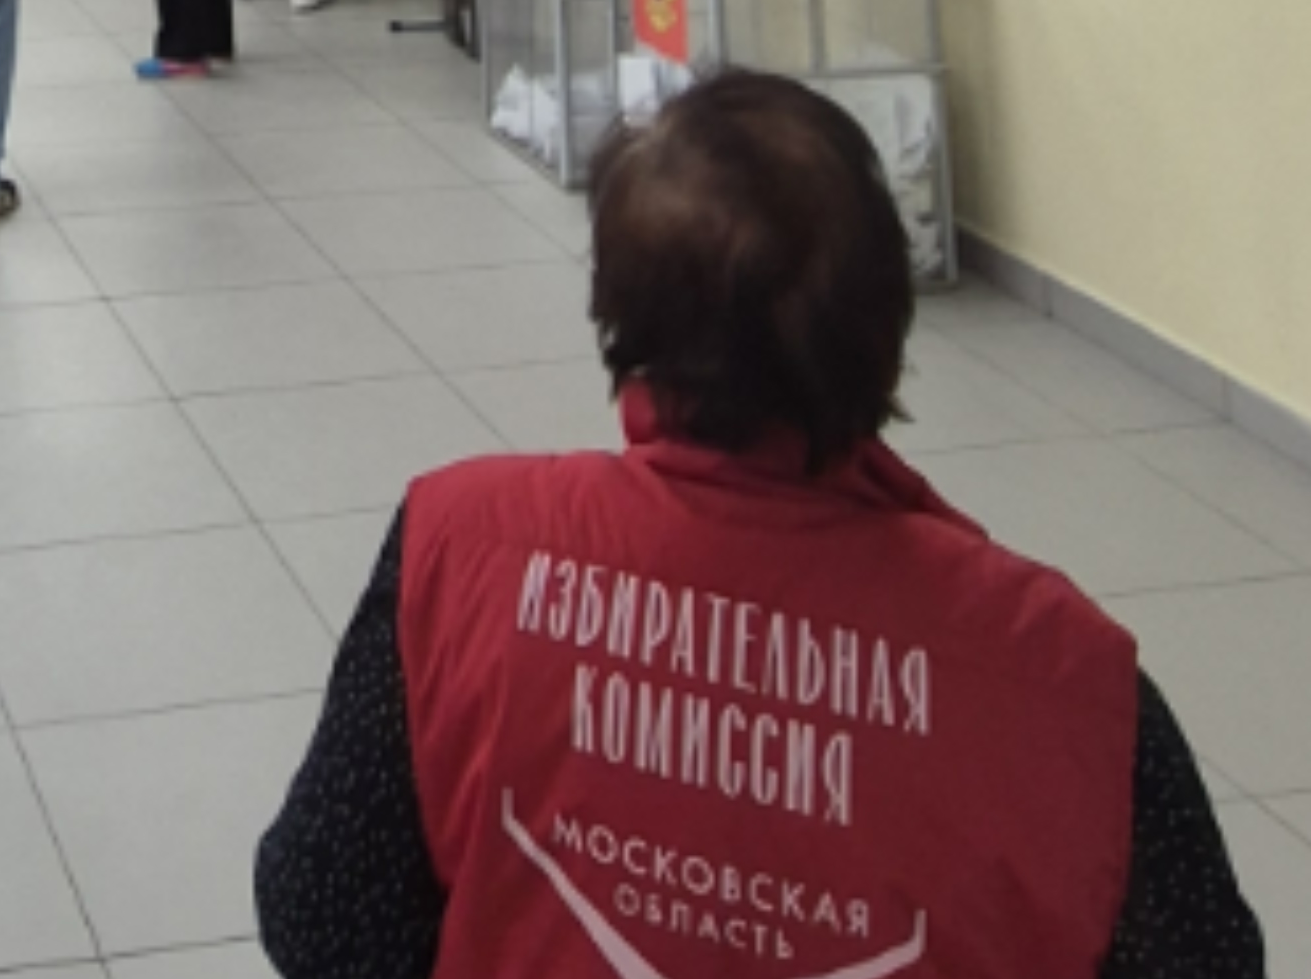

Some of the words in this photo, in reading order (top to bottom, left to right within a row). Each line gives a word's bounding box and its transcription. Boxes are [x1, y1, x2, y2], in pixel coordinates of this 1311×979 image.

[517, 549, 931, 737] ИЗБИРАТЕЛЬНАЯ
[571, 663, 854, 828] КОМИССИЯ
[552, 813, 871, 939] МОСКОВСКАЯ
[614, 884, 795, 961] ОБЛАСТЬ
